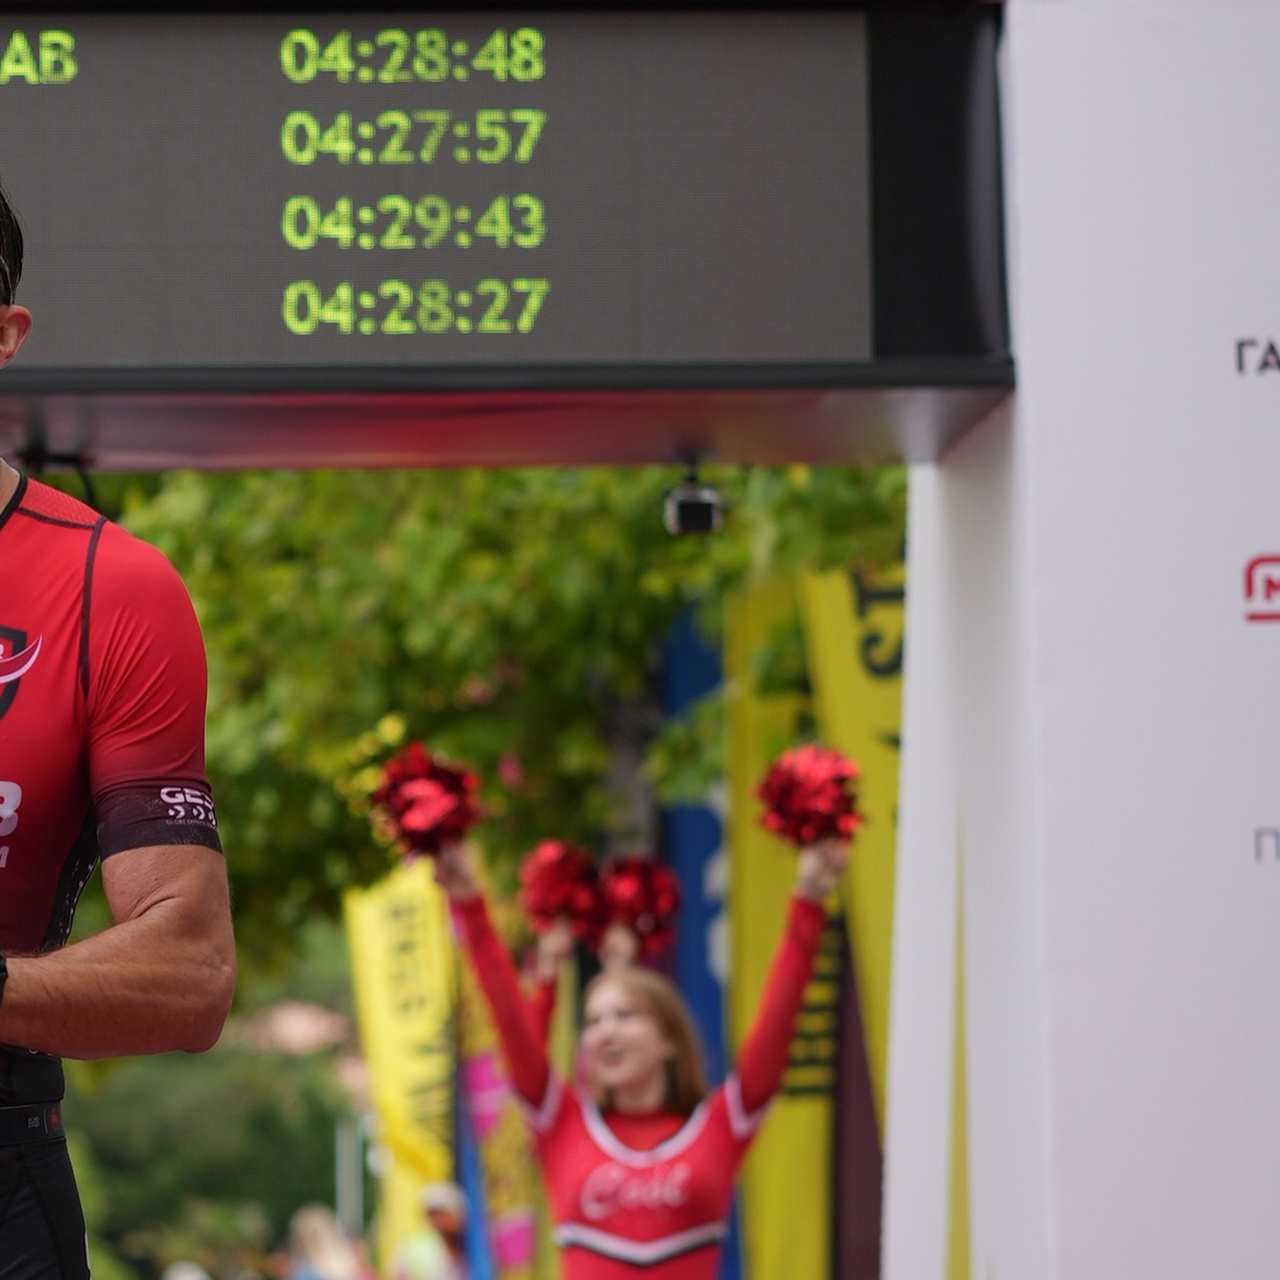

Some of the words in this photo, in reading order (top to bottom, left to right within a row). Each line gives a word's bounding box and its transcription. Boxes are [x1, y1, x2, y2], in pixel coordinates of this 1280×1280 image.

[280, 27, 546, 83] 04:28:48
[281, 108, 547, 165] 04:27:57
[281, 193, 547, 250] 04:29:43
[282, 277, 550, 335] 04:28:27
